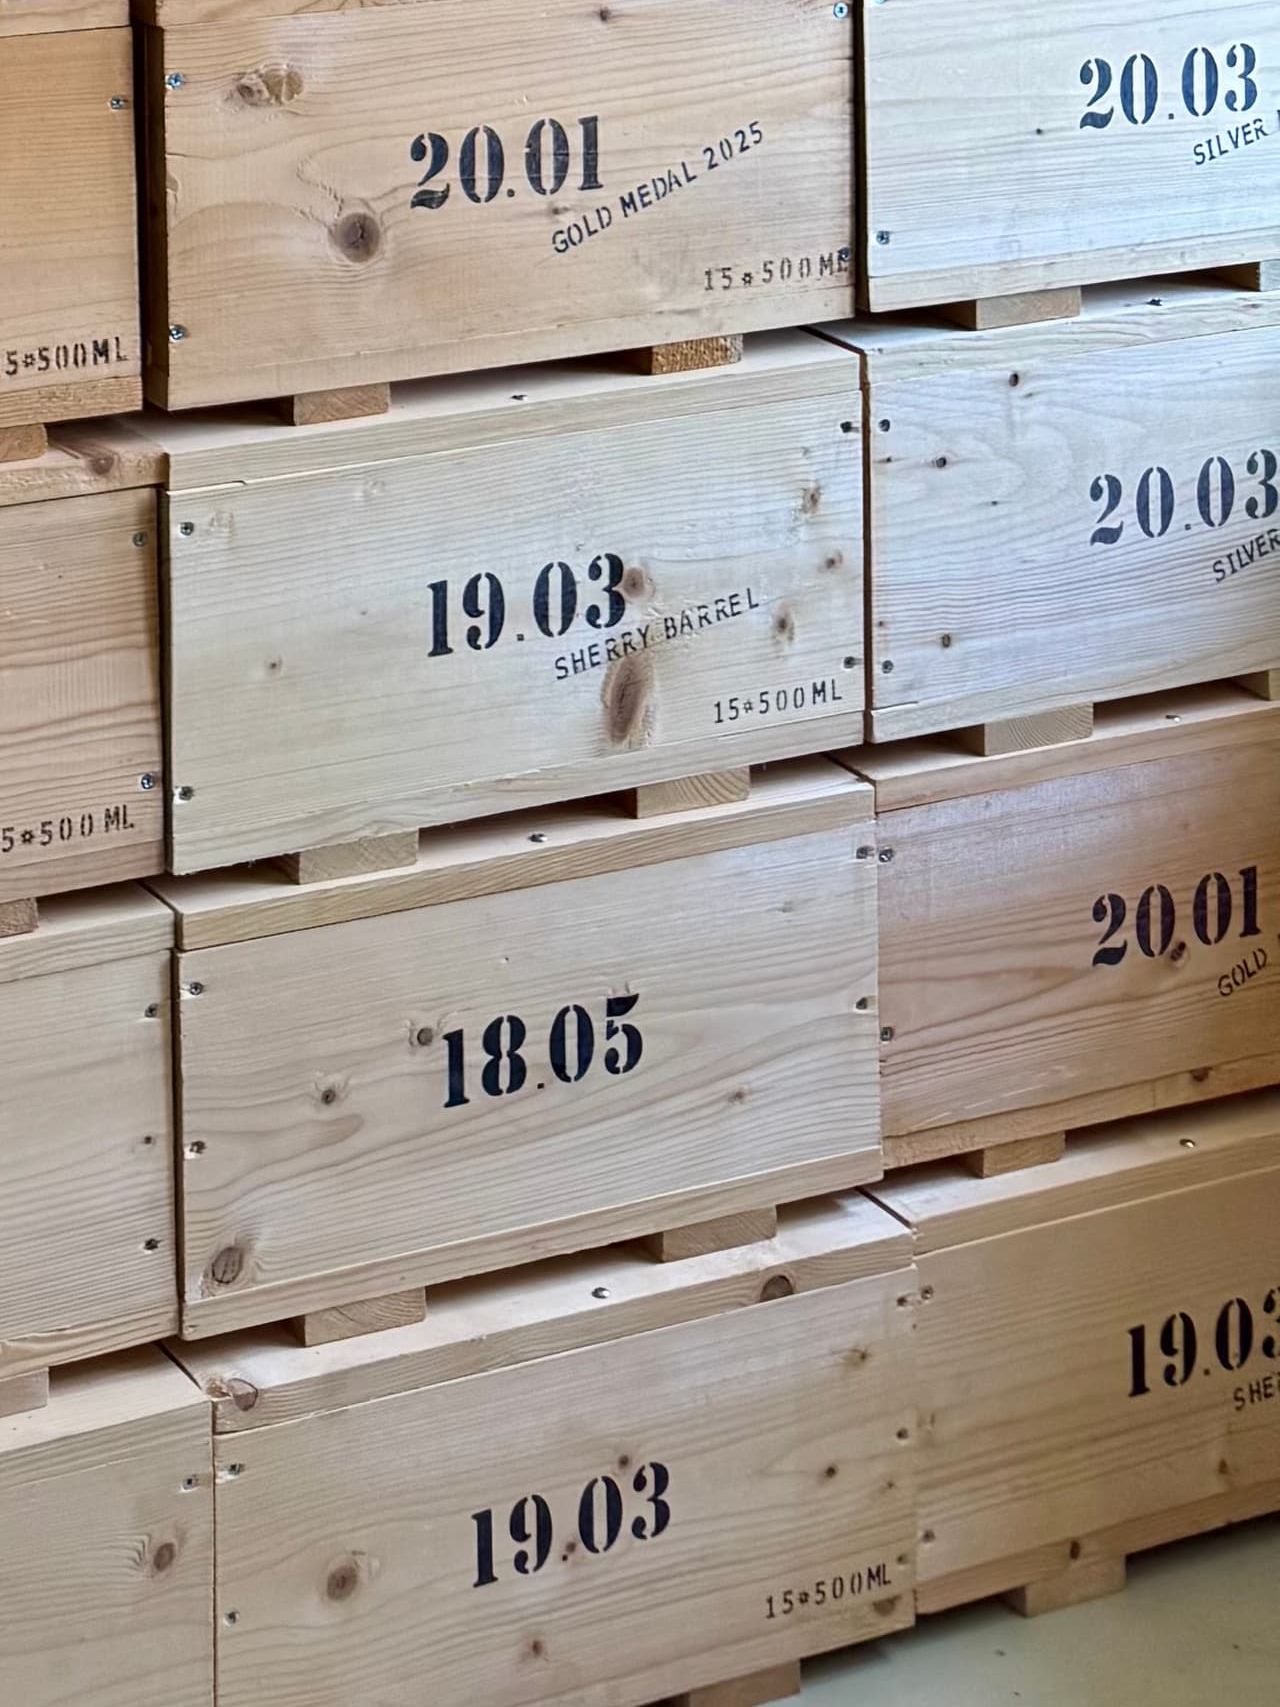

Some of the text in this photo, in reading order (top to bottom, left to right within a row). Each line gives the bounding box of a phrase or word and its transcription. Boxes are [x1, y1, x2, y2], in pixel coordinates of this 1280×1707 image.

[1079, 43, 1259, 130] 20.03
[410, 115, 603, 210] 20.01
[552, 121, 764, 254] GOLD MEDAL 2025
[1192, 118, 1269, 166] SILVER
[1090, 449, 1279, 546] 20.03
[1213, 528, 1280, 583] SILVER
[428, 553, 626, 657] 19.03
[554, 587, 760, 681] SHERRY BARREL
[1092, 865, 1261, 968] 20.01
[1217, 948, 1268, 998] GOLD
[442, 992, 644, 1108] 18.05
[1233, 1371, 1280, 1412] SHE
[471, 1461, 672, 1588] 19.03
